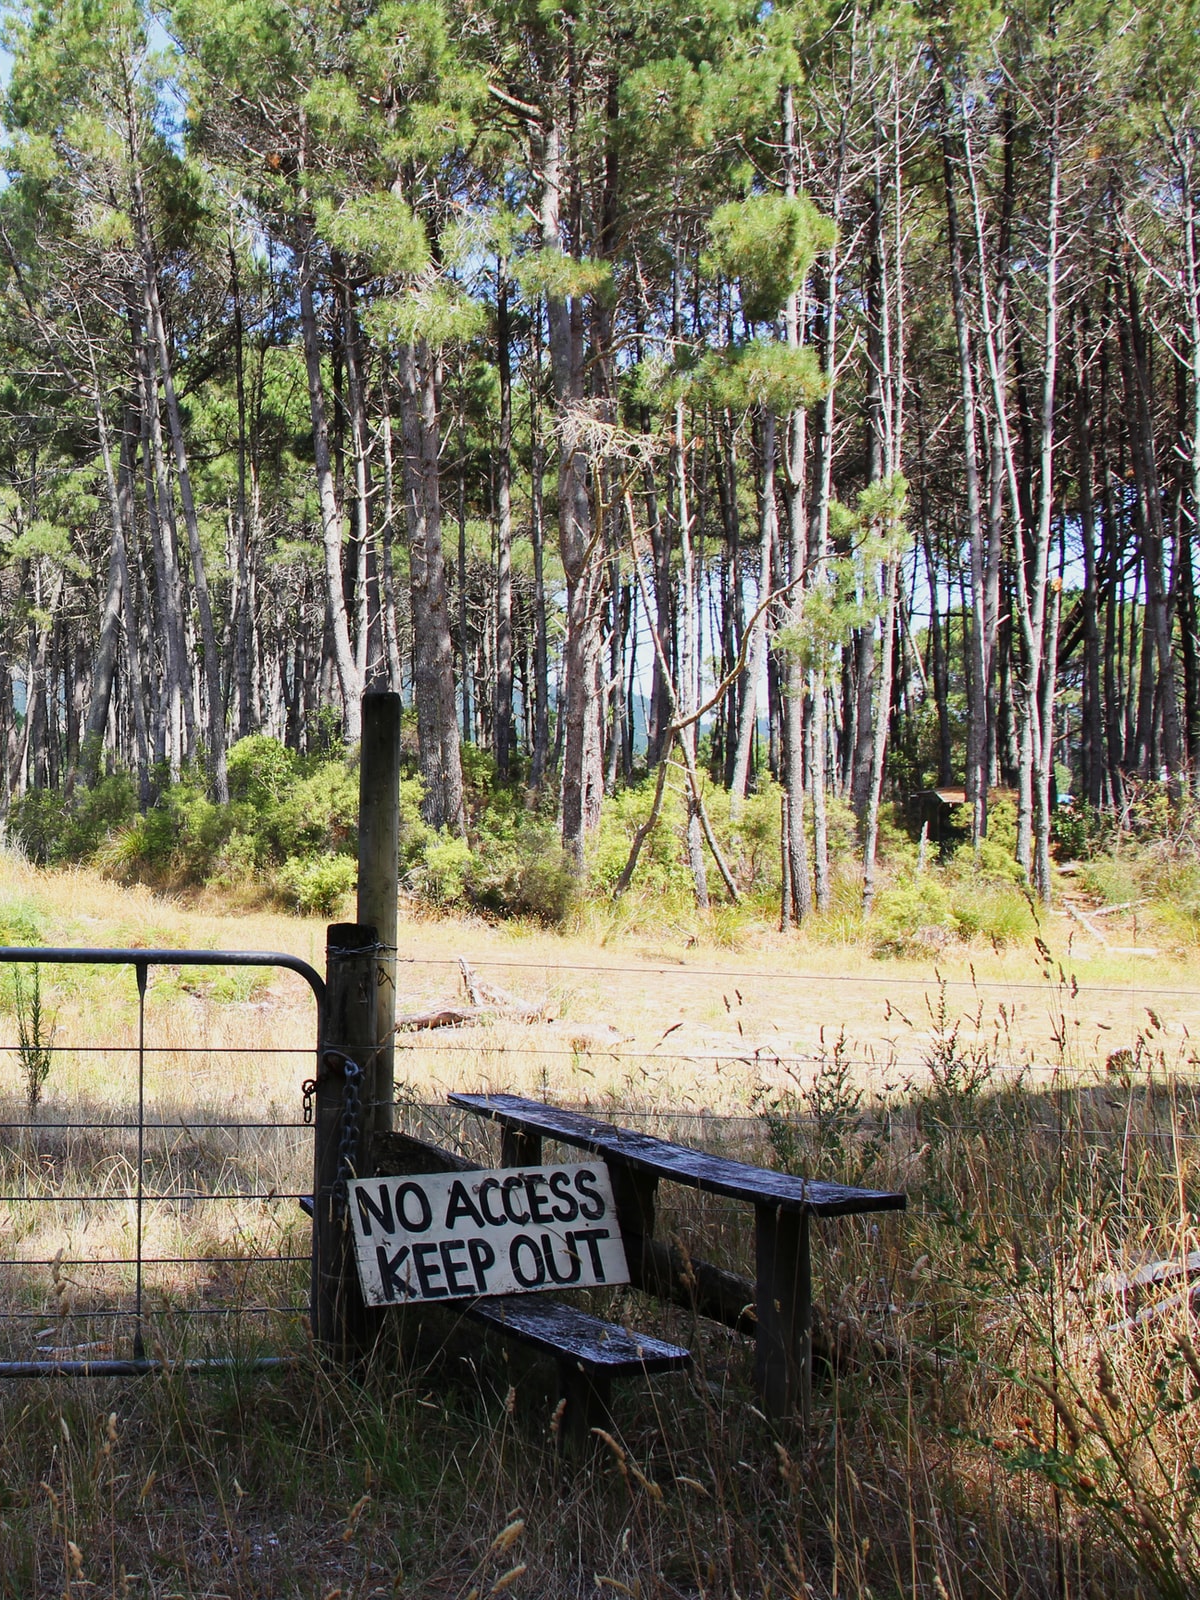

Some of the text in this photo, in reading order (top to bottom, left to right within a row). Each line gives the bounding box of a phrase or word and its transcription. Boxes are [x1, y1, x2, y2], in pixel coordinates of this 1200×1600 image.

[355, 1169, 605, 1235] NO ACCESS
[376, 1230, 610, 1301] KEEP OUT
